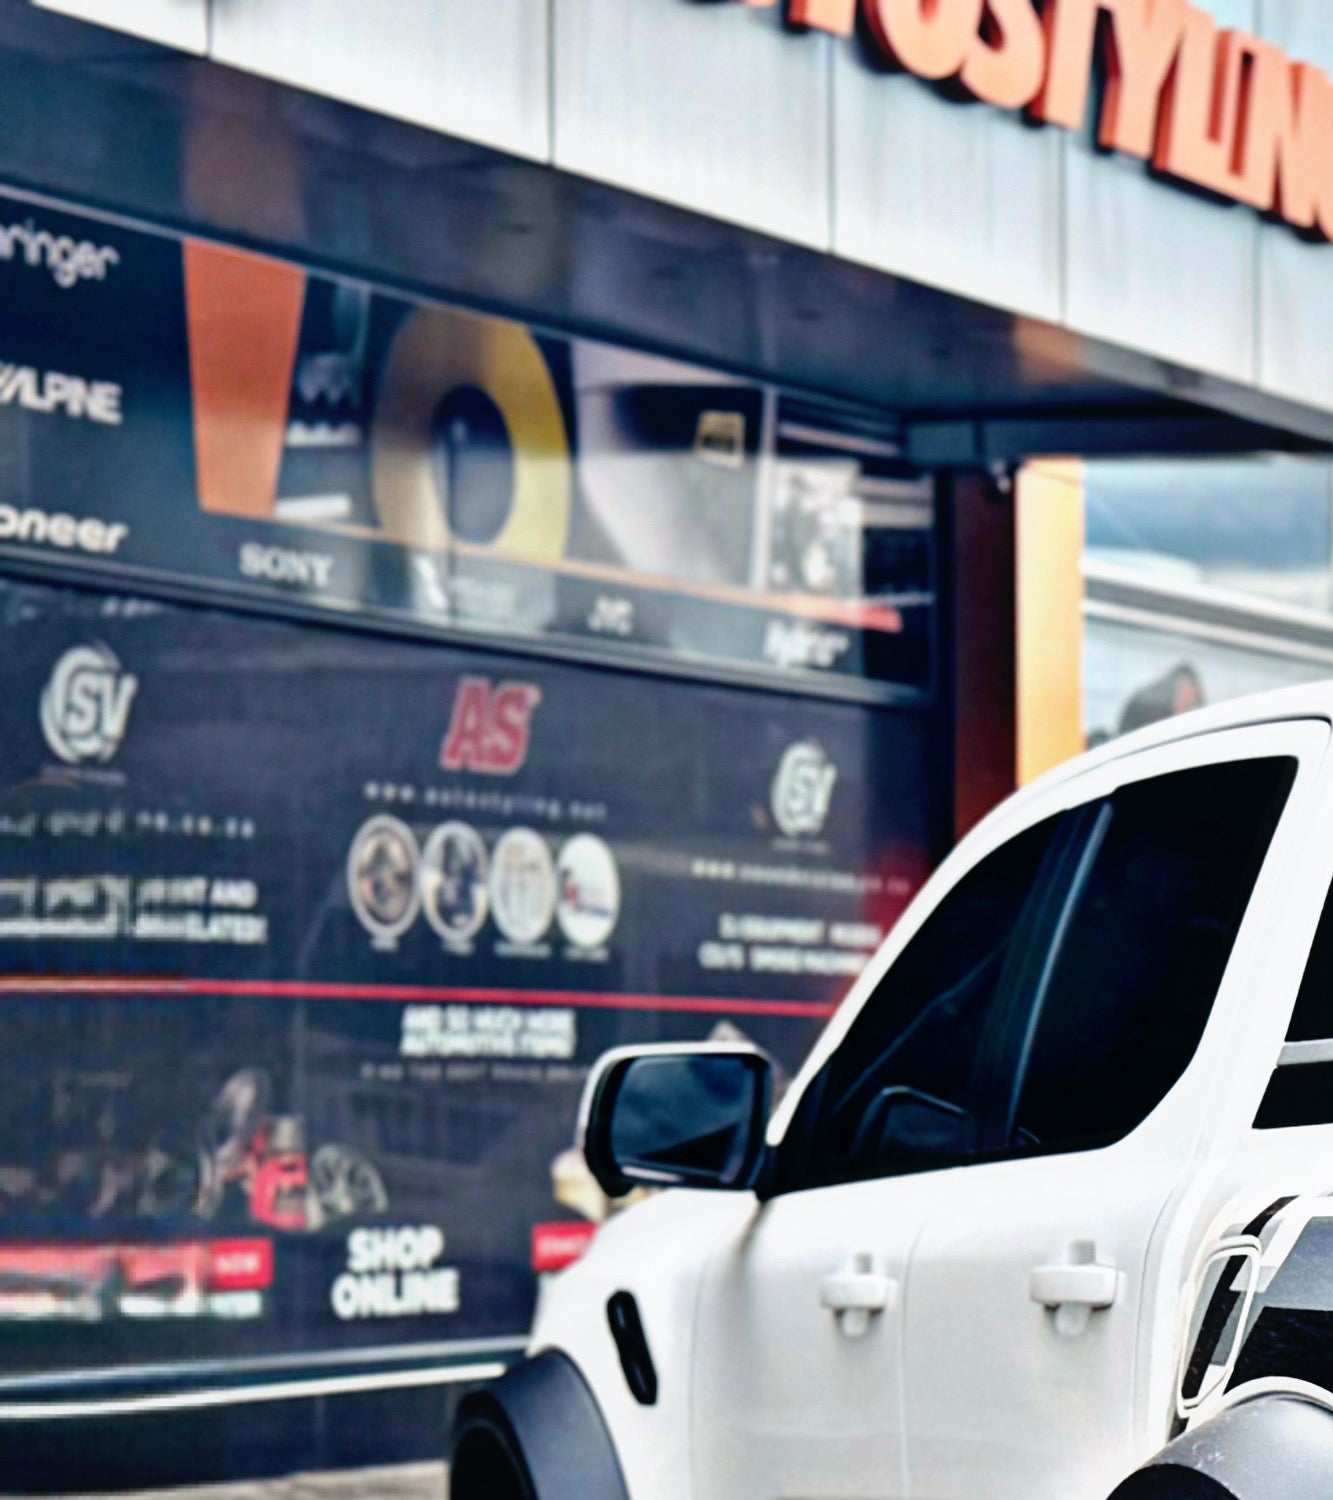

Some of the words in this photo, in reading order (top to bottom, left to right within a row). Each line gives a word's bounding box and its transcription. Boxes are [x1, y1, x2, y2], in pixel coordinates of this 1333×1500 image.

[239, 541, 335, 588] SONY
[438, 675, 542, 776] AS
[347, 1225, 444, 1273] SHOP
[331, 1267, 460, 1320] ONLINE
